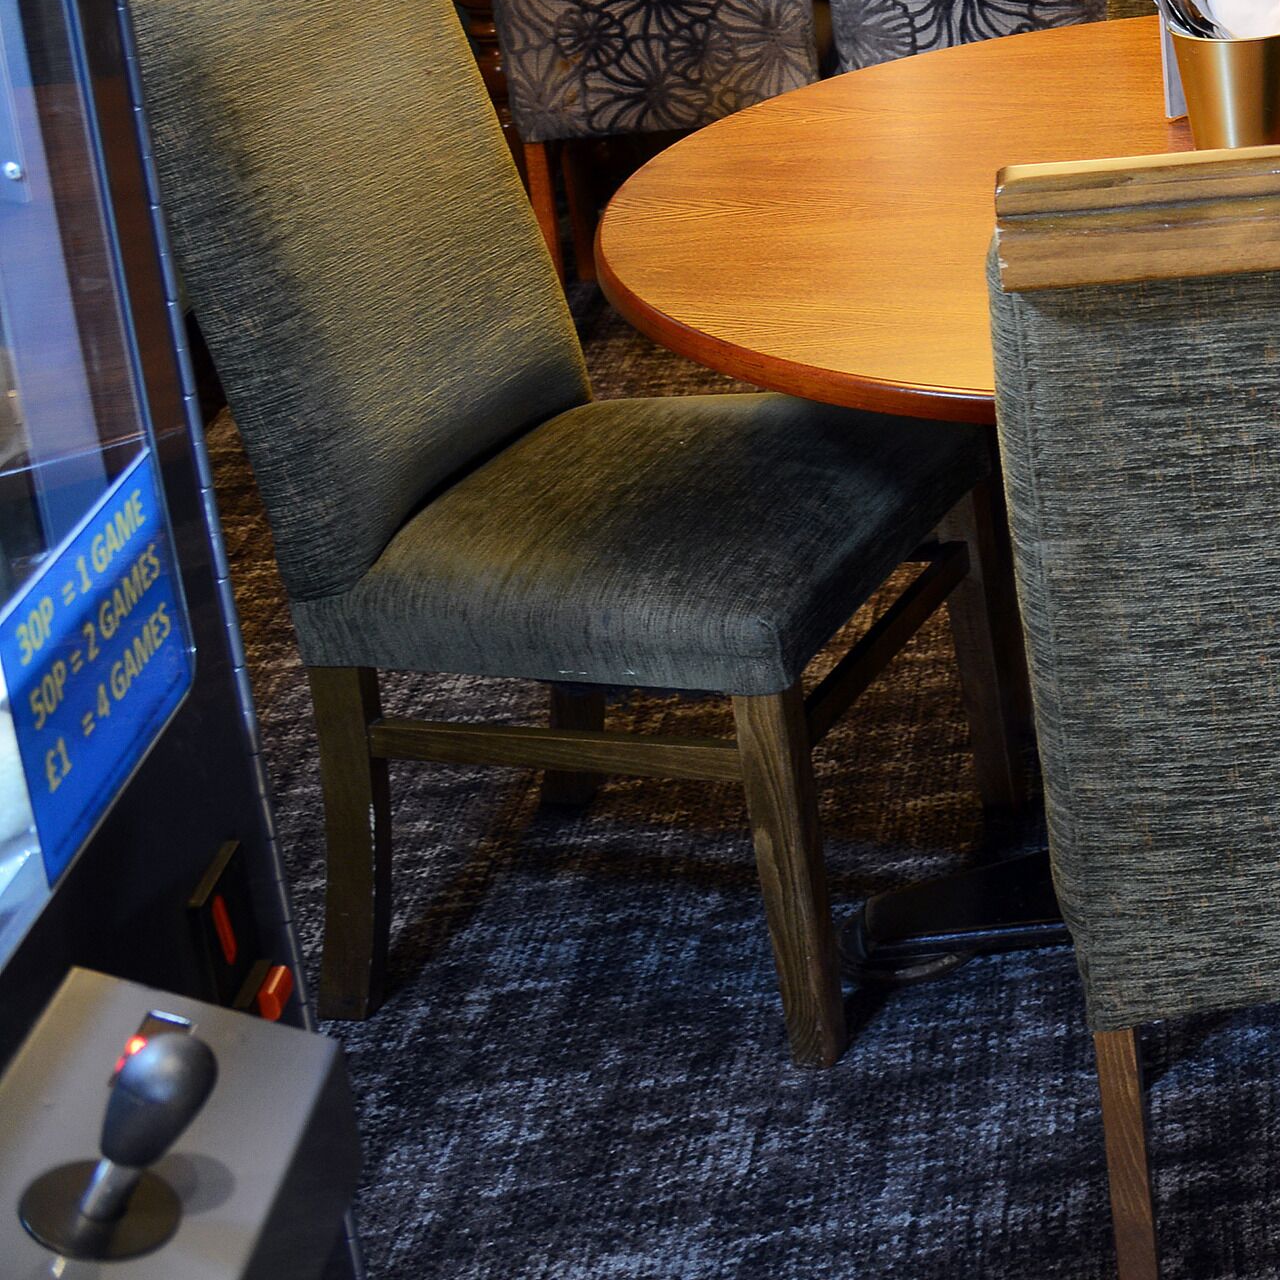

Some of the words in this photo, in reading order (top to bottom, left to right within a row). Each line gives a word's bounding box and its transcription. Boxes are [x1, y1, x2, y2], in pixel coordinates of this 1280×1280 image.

[15, 595, 54, 666] 30P
[76, 555, 92, 594] 1
[91, 489, 146, 573] GAME
[29, 659, 67, 730] 50P
[82, 622, 100, 662] 2
[99, 543, 160, 640] GAMES
[44, 736, 73, 794] £1
[96, 682, 111, 718] 4
[110, 602, 171, 701] GAMES
